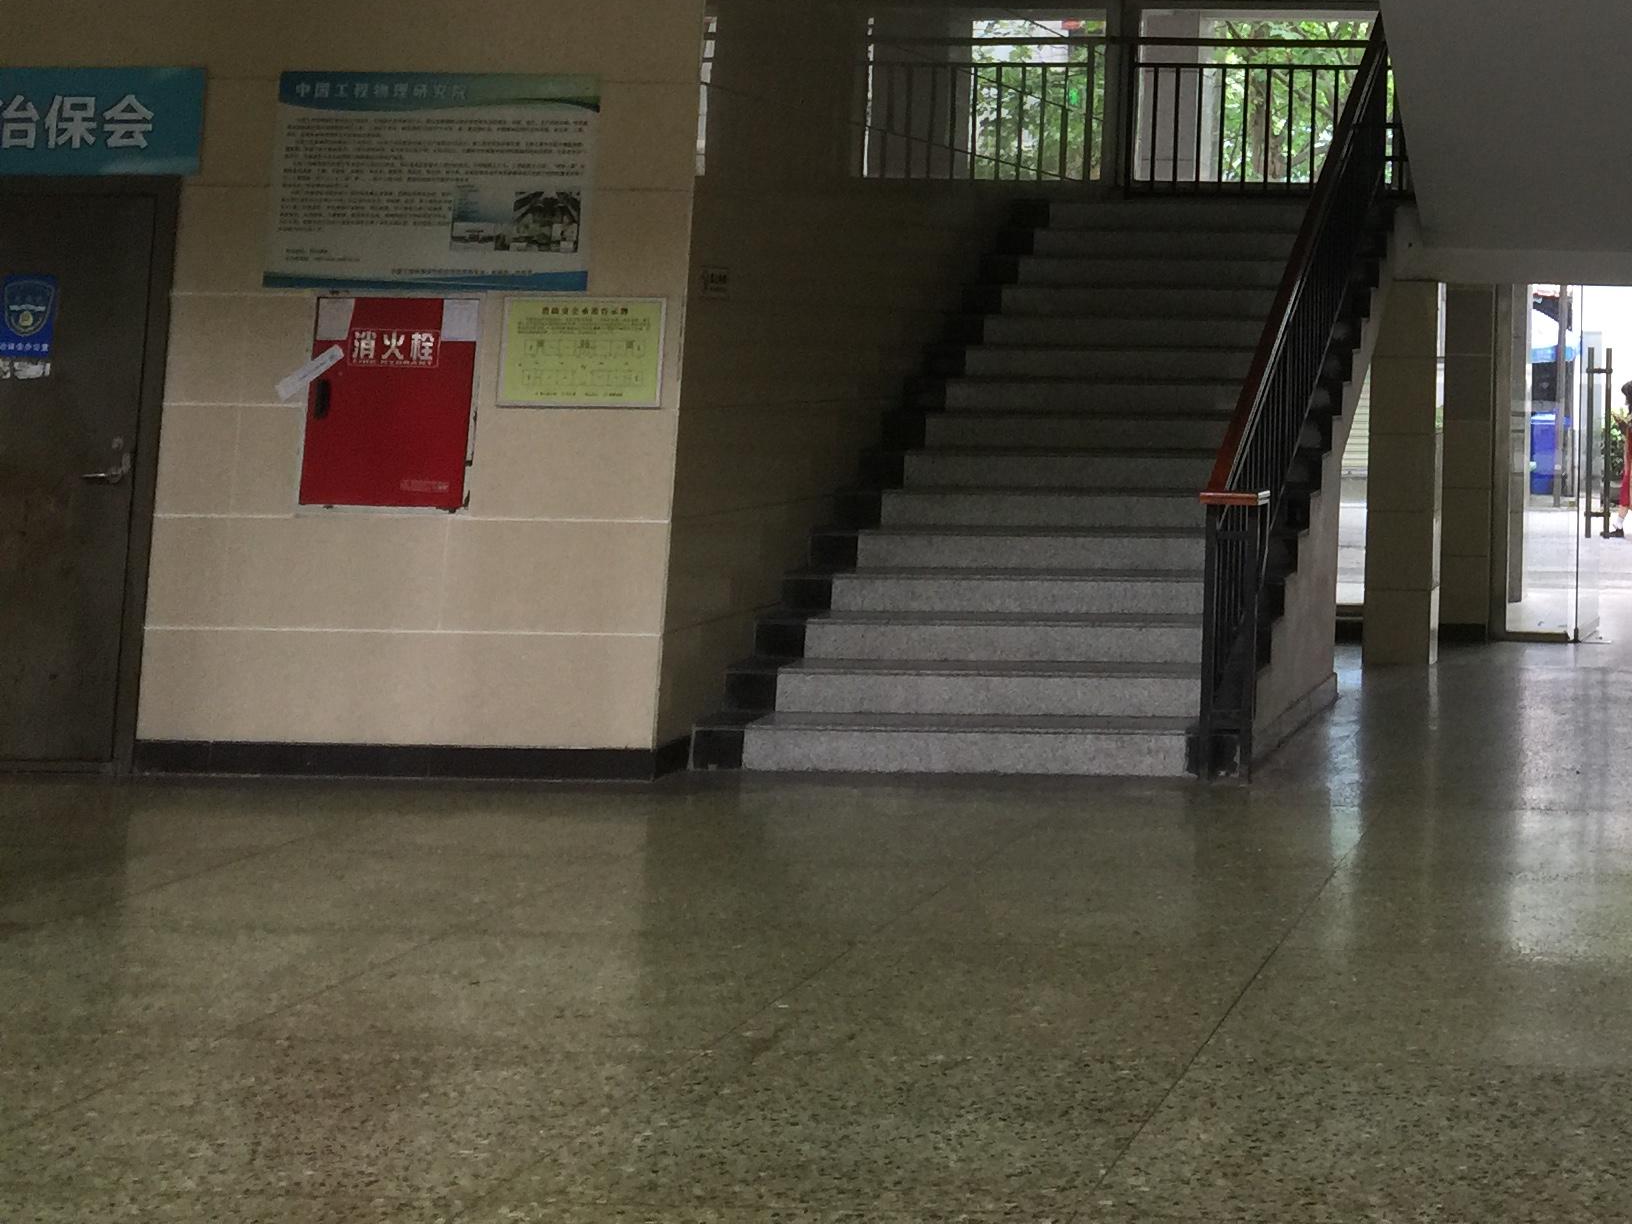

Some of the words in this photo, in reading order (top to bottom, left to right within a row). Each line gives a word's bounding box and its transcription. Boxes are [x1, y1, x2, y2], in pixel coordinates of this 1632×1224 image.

[295, 81, 467, 102] 中国工程物理研究院
[0, 94, 154, 149] 治保会
[352, 331, 435, 361] 消火栓
